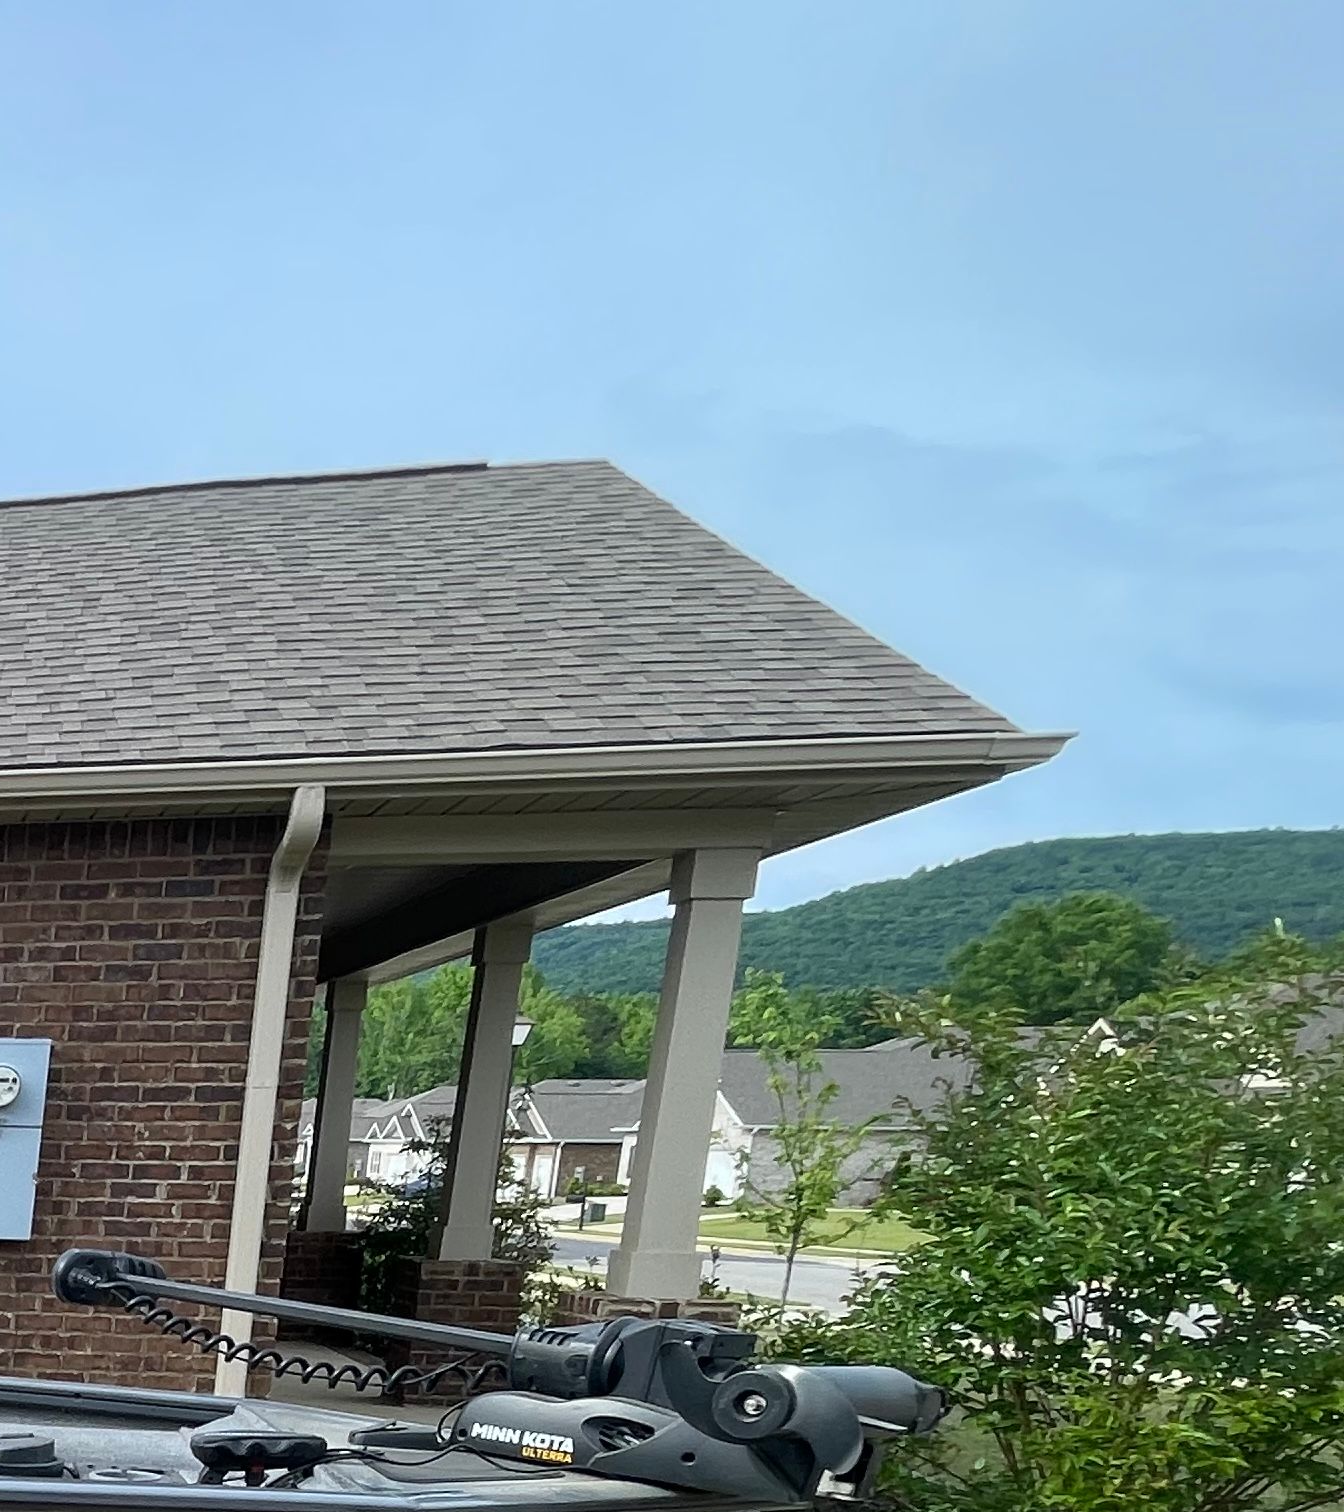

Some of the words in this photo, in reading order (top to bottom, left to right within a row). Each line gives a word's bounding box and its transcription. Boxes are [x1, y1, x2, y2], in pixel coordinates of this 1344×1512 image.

[470, 1422, 521, 1445] MINN
[521, 1430, 574, 1453] KOTA
[521, 1446, 573, 1464] ULTERRA
